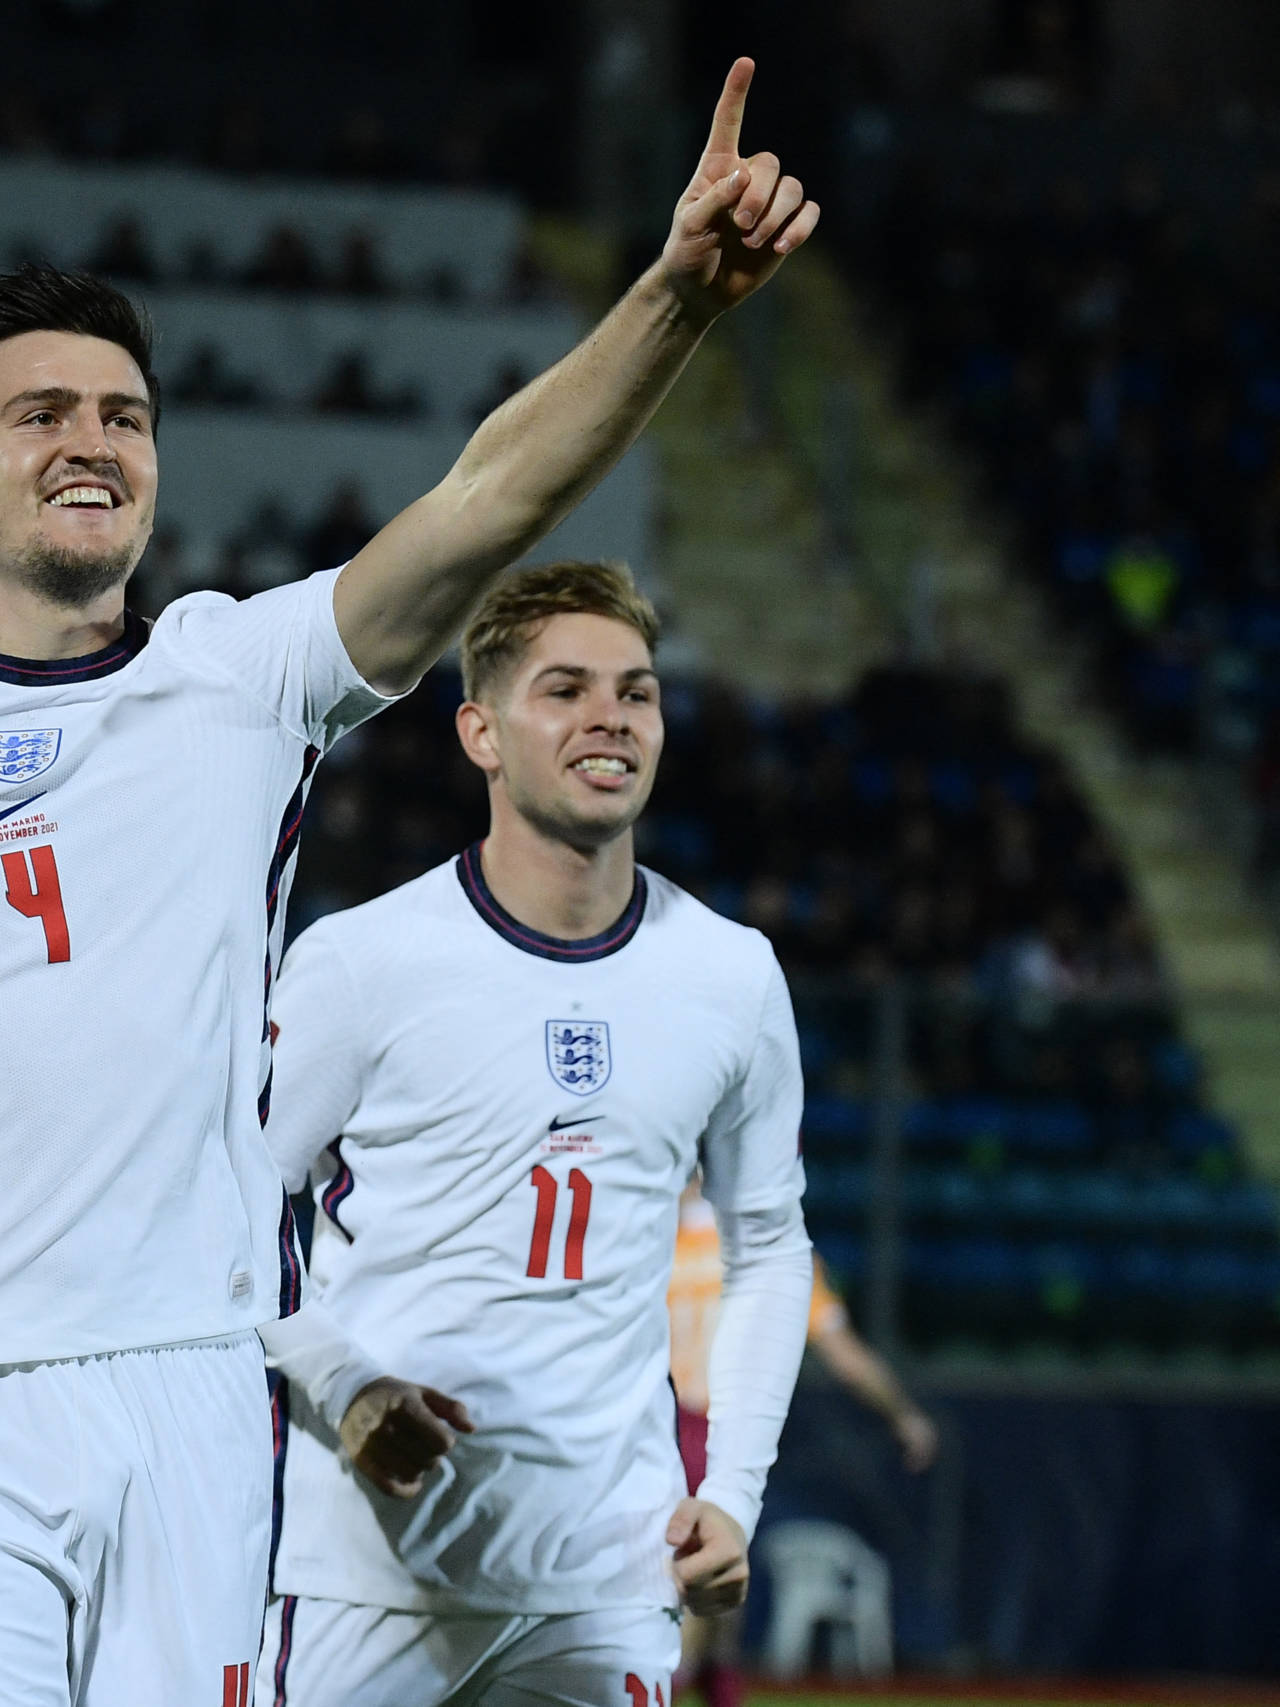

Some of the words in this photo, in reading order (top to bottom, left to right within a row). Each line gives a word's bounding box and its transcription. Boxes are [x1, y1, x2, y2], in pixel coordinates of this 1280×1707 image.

[11, 813, 46, 827] MARINO
[40, 821, 59, 834] 2021
[0, 844, 71, 964] 4
[526, 1163, 592, 1280] 11
